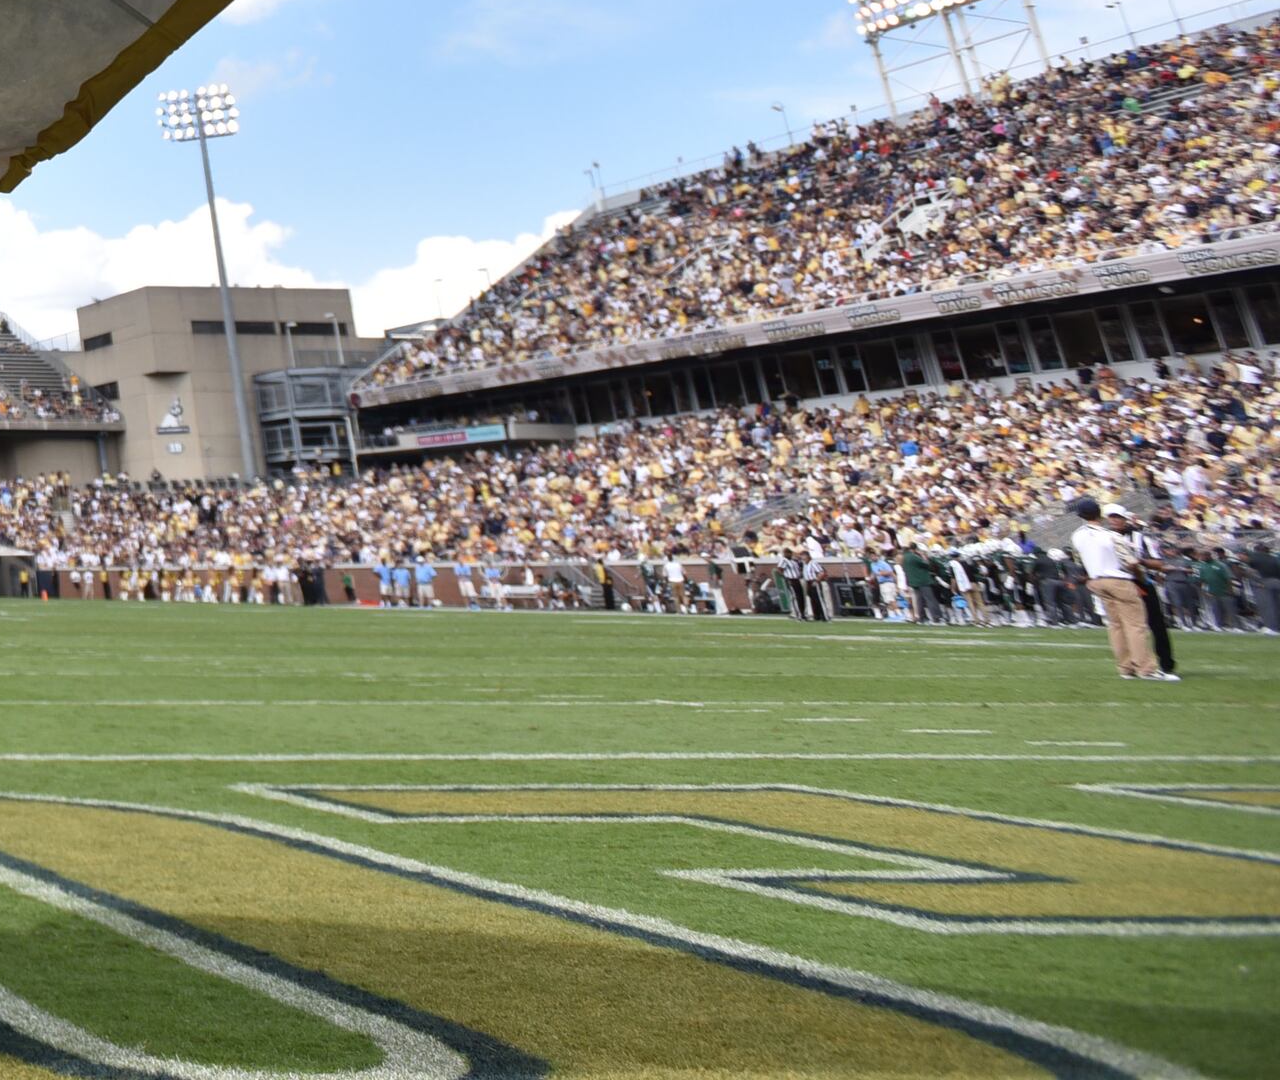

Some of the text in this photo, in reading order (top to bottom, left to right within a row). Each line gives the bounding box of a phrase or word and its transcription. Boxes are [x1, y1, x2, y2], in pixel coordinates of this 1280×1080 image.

[1098, 269, 1151, 288] PUND
[995, 280, 1078, 306] HAMILTON
[938, 295, 982, 313] DAVIS
[849, 309, 901, 328] MORRIS
